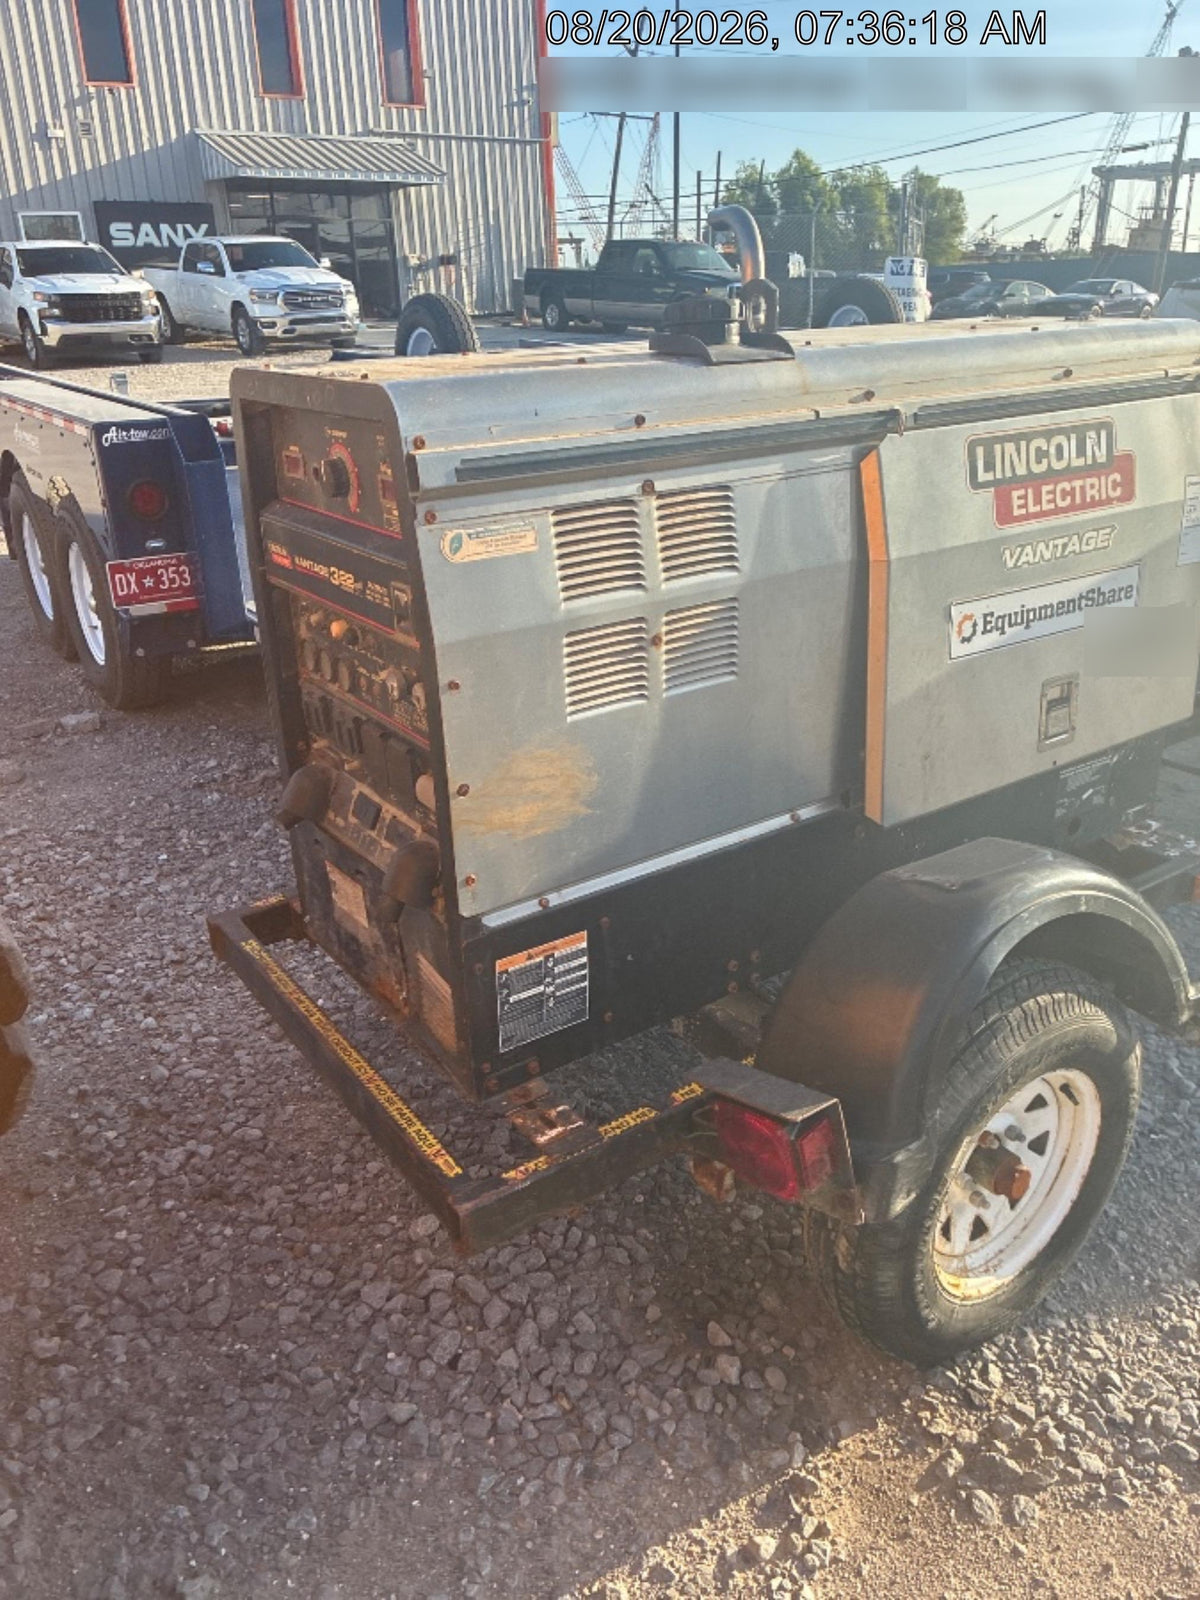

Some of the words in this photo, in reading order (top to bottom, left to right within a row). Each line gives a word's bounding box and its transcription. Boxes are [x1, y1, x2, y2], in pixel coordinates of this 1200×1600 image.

[109, 221, 208, 248] SANY
[975, 428, 1108, 483] LINCOLN
[1011, 472, 1123, 517] ELECTRIC
[1002, 525, 1117, 570] VANTAGE
[114, 572, 139, 597] DX
[157, 564, 191, 590] 353
[981, 585, 1135, 636] EquipmentShare
